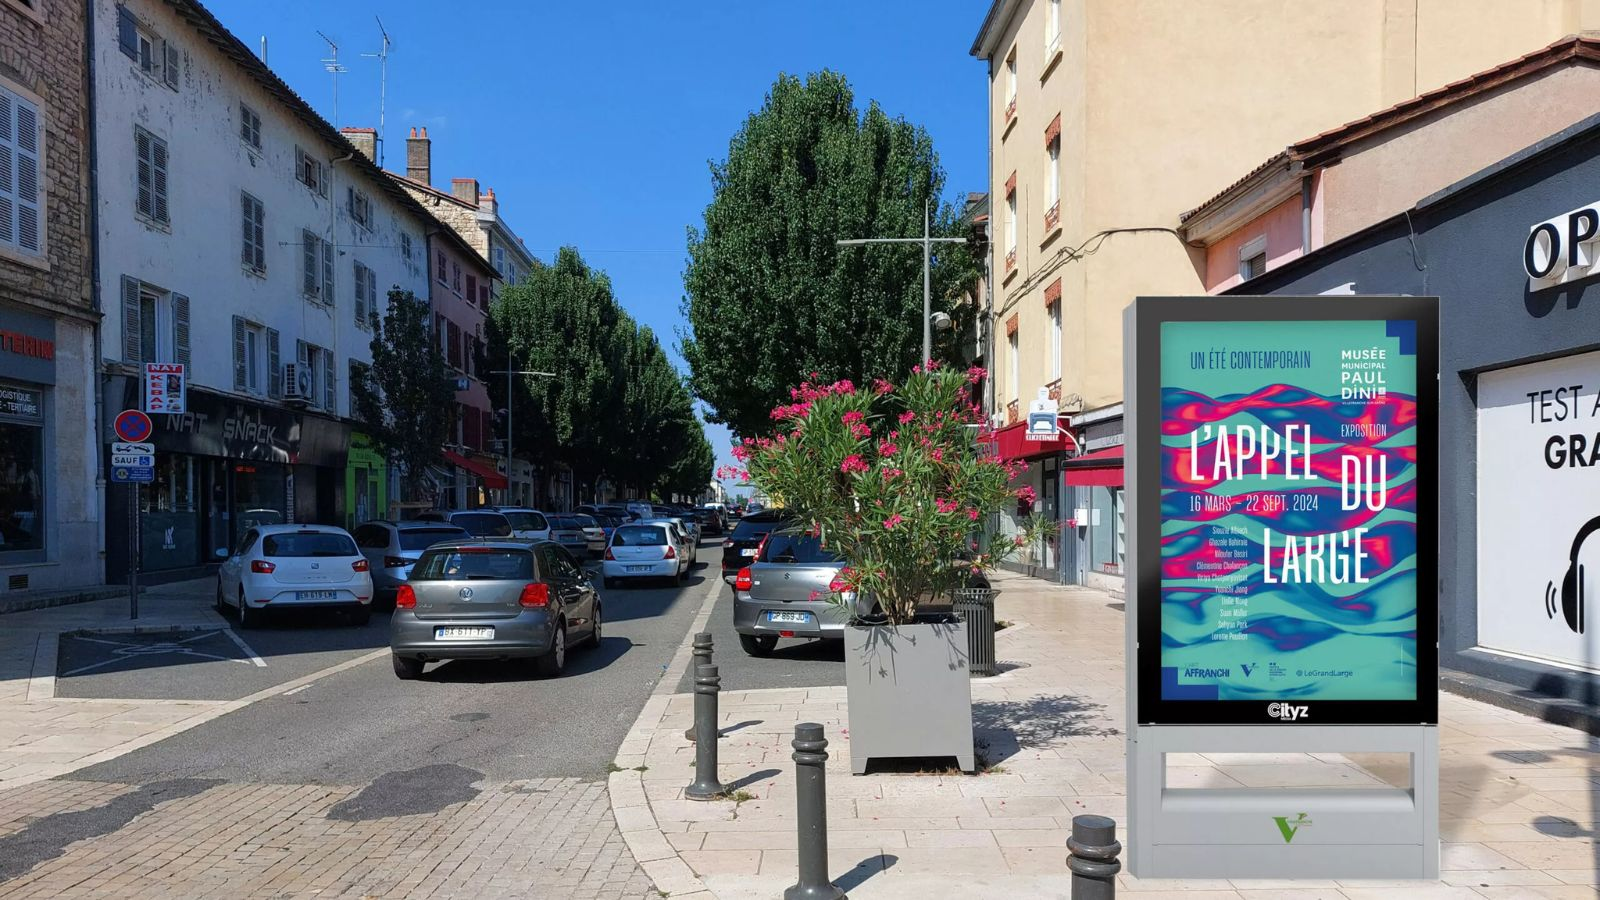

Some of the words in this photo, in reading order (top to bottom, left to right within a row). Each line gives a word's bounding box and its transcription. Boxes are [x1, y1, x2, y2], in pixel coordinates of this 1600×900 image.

[1524, 208, 1600, 279] OP
[1190, 351, 1205, 370] UN
[1209, 346, 1226, 370] ÉTÉ
[1230, 350, 1311, 370] CONTEMPORAIN
[1341, 346, 1387, 360] MUSÉE
[1341, 361, 1387, 370] MUNICIPAL
[1341, 371, 1386, 384] PAUL
[1341, 384, 1377, 400] DINI
[1526, 384, 1583, 424] TEST
[166, 411, 208, 435] NAT
[223, 417, 276, 444] SNACK
[1341, 423, 1387, 438] EXPOSITION
[1341, 454, 1387, 512] DU
[1190, 495, 1201, 512] 16
[1204, 495, 1232, 512] MARS
[1246, 494, 1259, 512] 22
[1263, 494, 1289, 511] SEPT.
[1293, 494, 1318, 511] 2024
[1263, 527, 1370, 584] LARGE
[1184, 668, 1230, 679] AFFRANCHI
[1267, 702, 1309, 721] Cityz
